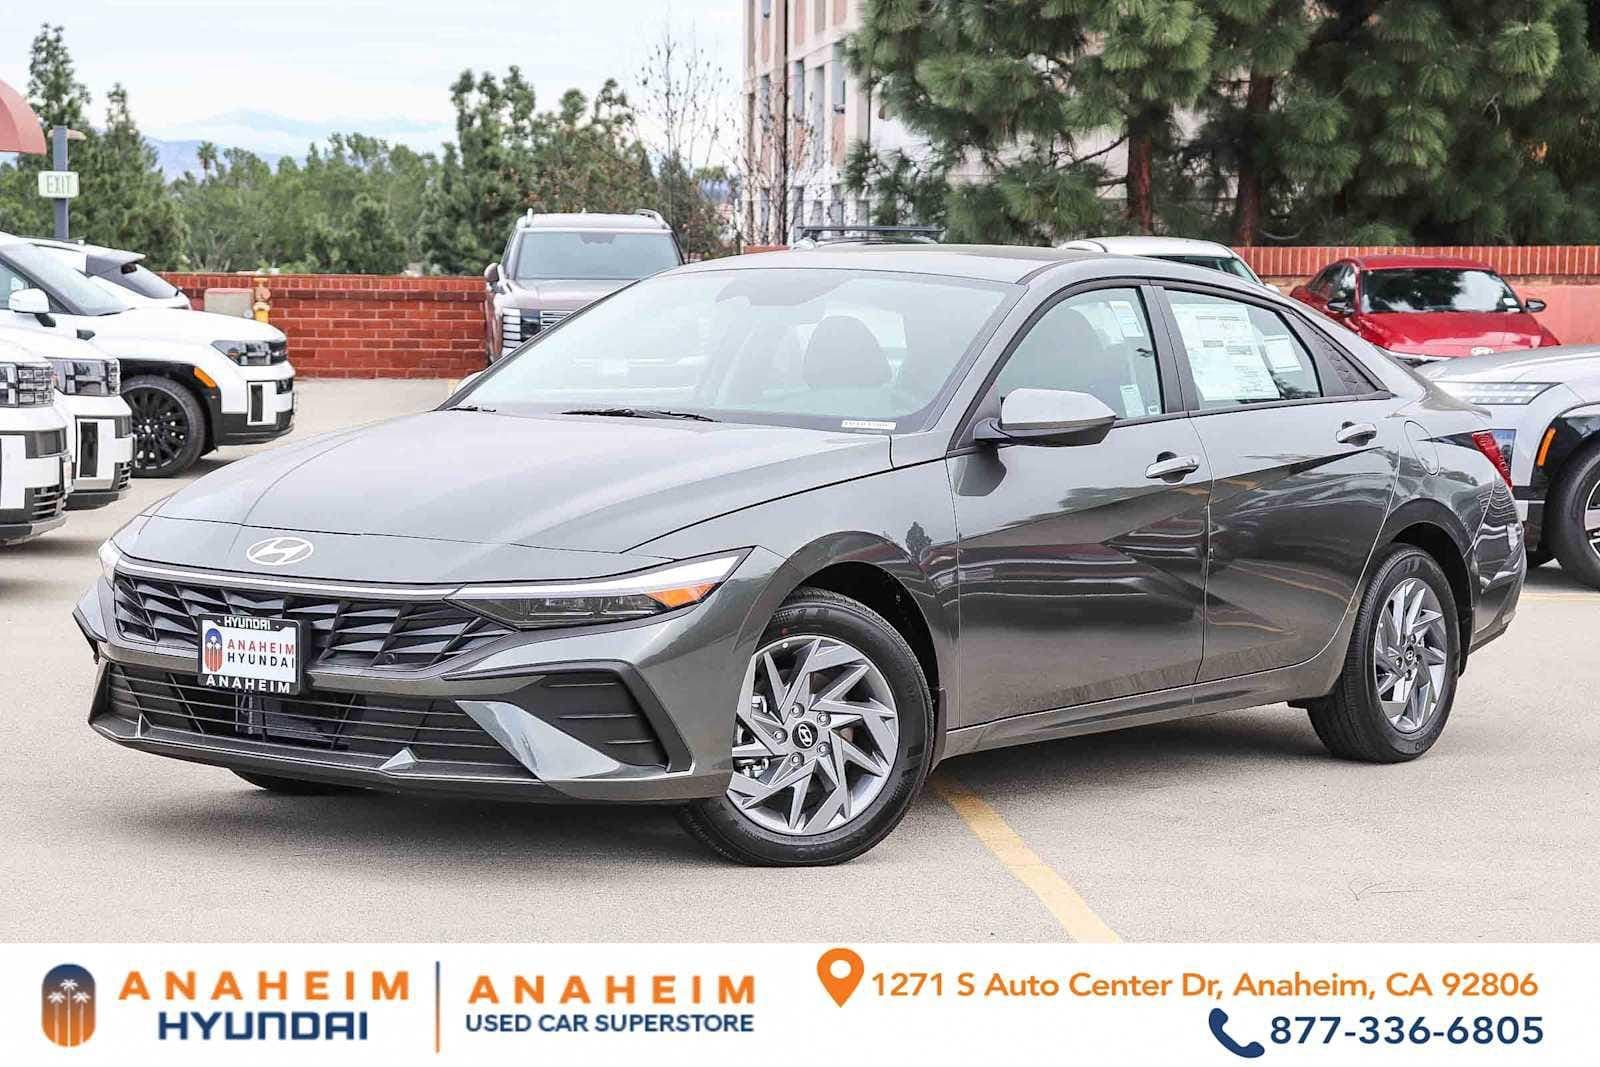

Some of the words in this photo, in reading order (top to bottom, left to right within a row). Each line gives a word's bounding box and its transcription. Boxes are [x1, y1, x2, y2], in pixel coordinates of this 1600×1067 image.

[46, 174, 73, 194] EXIT
[224, 616, 271, 630] HYUNDAI
[227, 638, 295, 656] ANAHEIM
[227, 651, 295, 669] HYUNDAI
[205, 674, 291, 694] ANAHEIM
